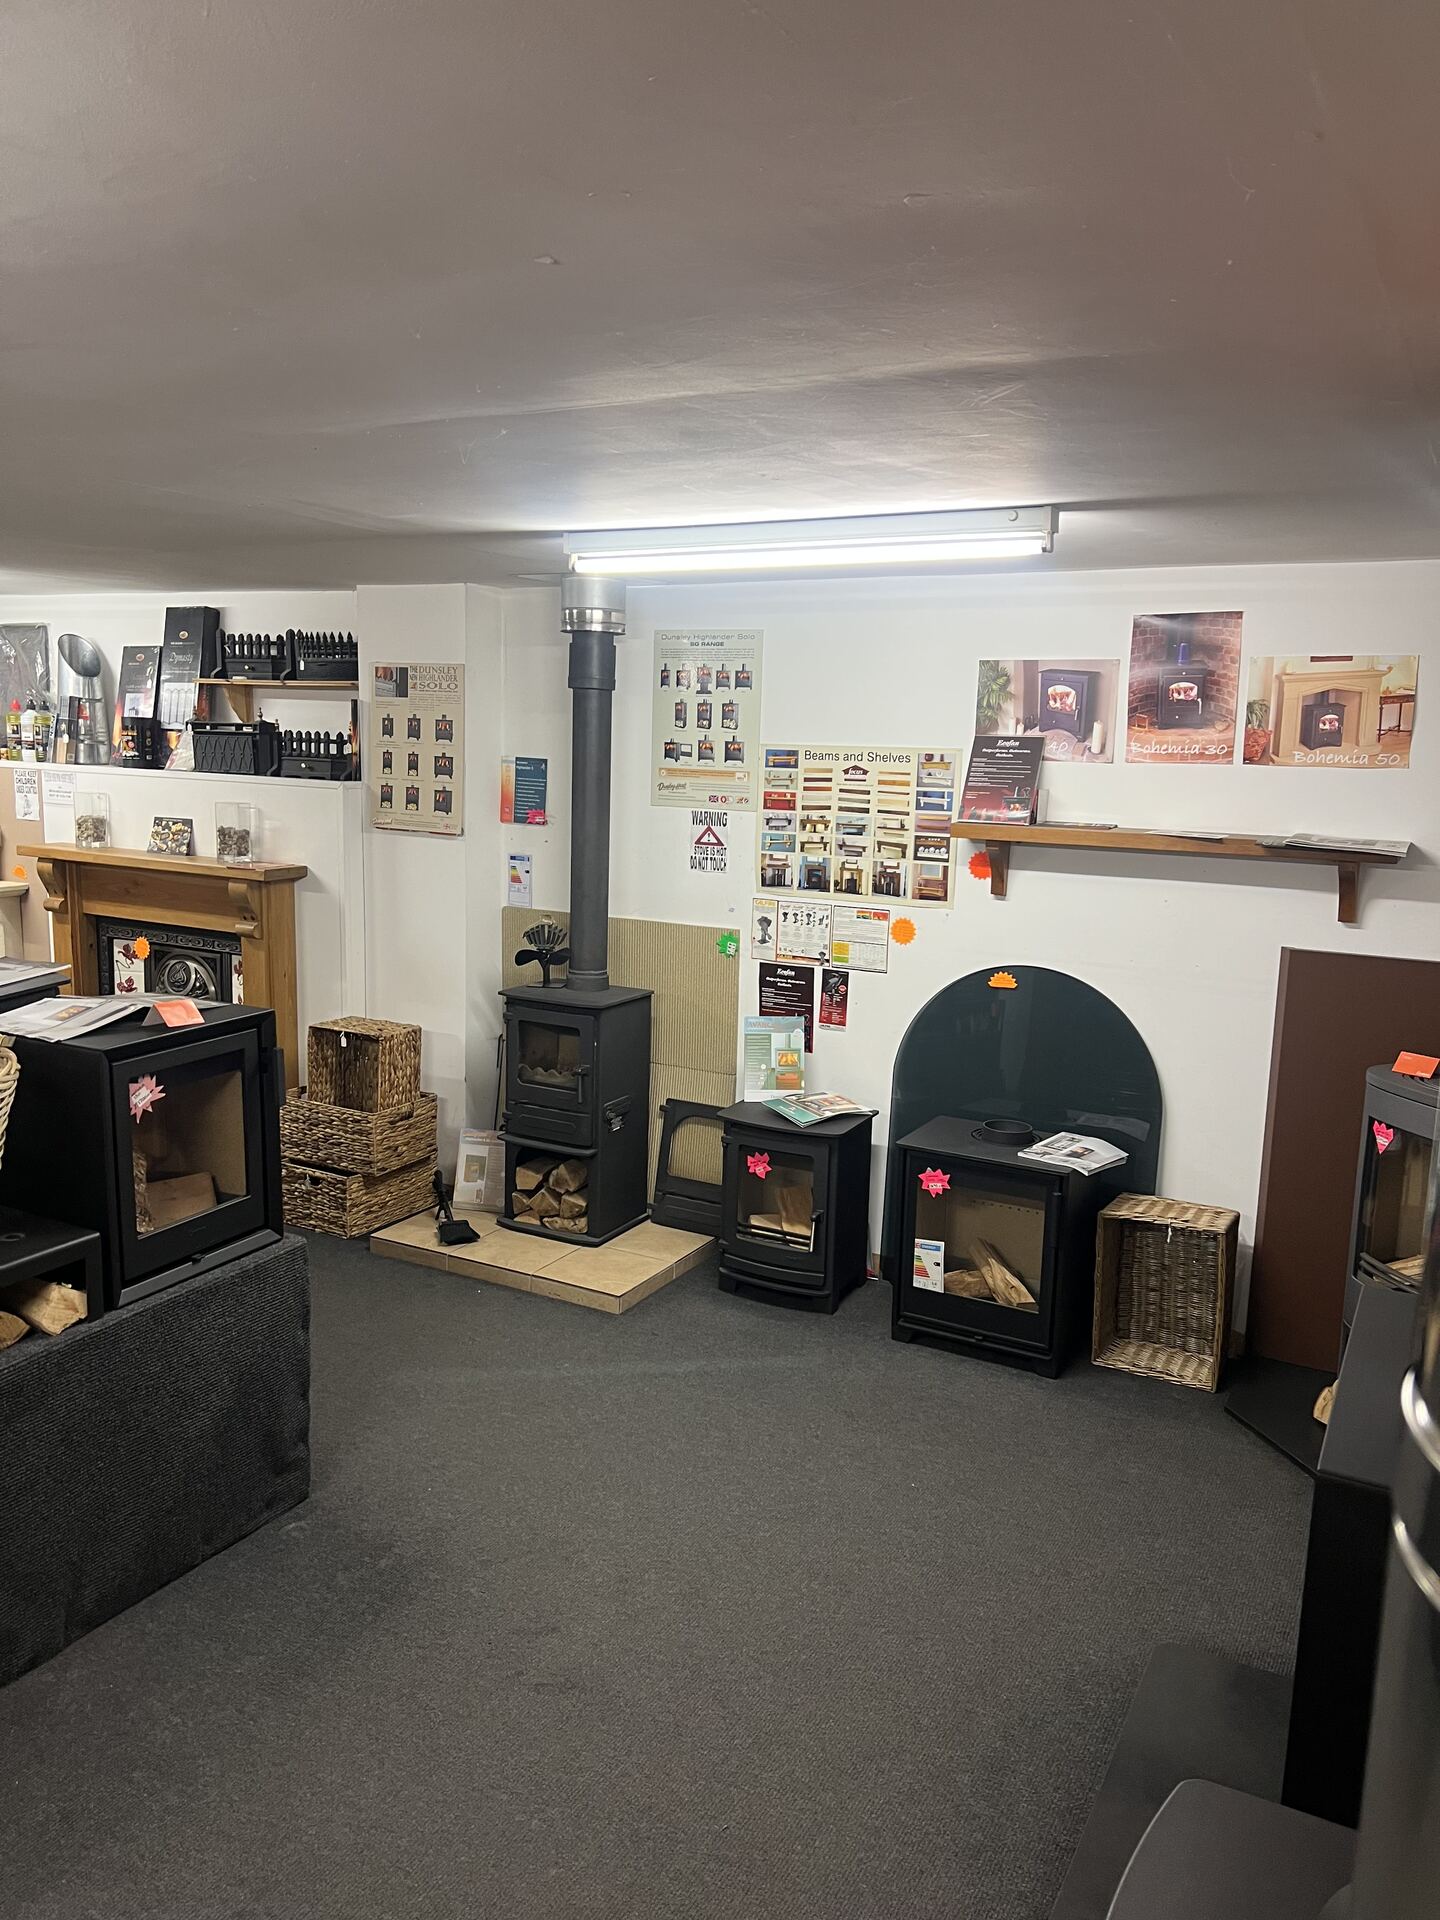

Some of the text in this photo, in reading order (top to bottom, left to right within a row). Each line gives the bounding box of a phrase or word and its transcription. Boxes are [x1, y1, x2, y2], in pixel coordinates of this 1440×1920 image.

[661, 633, 756, 642] Dunsley Highlander Solo
[419, 666, 458, 675] DUNSLEY
[419, 674, 458, 682] HIGHLANDER
[419, 682, 458, 690] SOLO
[1130, 740, 1228, 756] Bohemia 30
[804, 749, 911, 763] Beams and Shelves
[1292, 749, 1400, 765] Bohemia 50
[16, 777, 36, 785] CHILDREN
[691, 811, 728, 827] WARNING
[694, 846, 727, 857] STOVE IS HOT
[690, 856, 727, 872] DO NOT TOUCH
